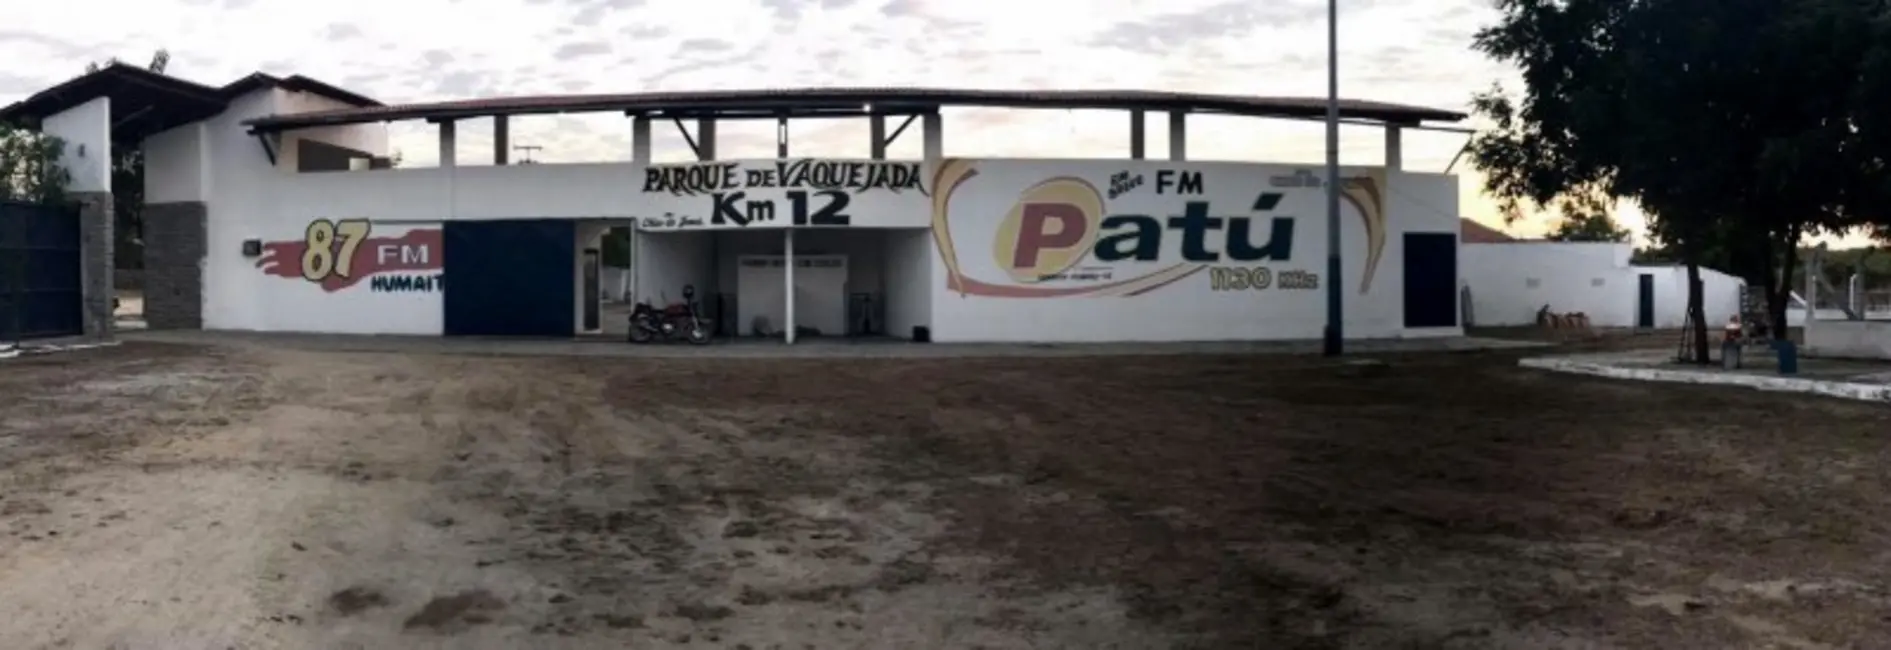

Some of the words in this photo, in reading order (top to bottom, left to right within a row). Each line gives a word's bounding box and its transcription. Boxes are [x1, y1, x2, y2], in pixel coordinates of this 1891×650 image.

[643, 164, 740, 197] PARQUE
[745, 169, 777, 188] DE
[776, 158, 930, 197] VAQUEJADA
[1156, 169, 1204, 195] FM
[711, 191, 775, 226] Km
[786, 191, 850, 226] 12
[1013, 192, 1295, 269] Patú
[302, 218, 371, 282] 87
[377, 244, 429, 265] FM
[1209, 266, 1271, 291] 1130
